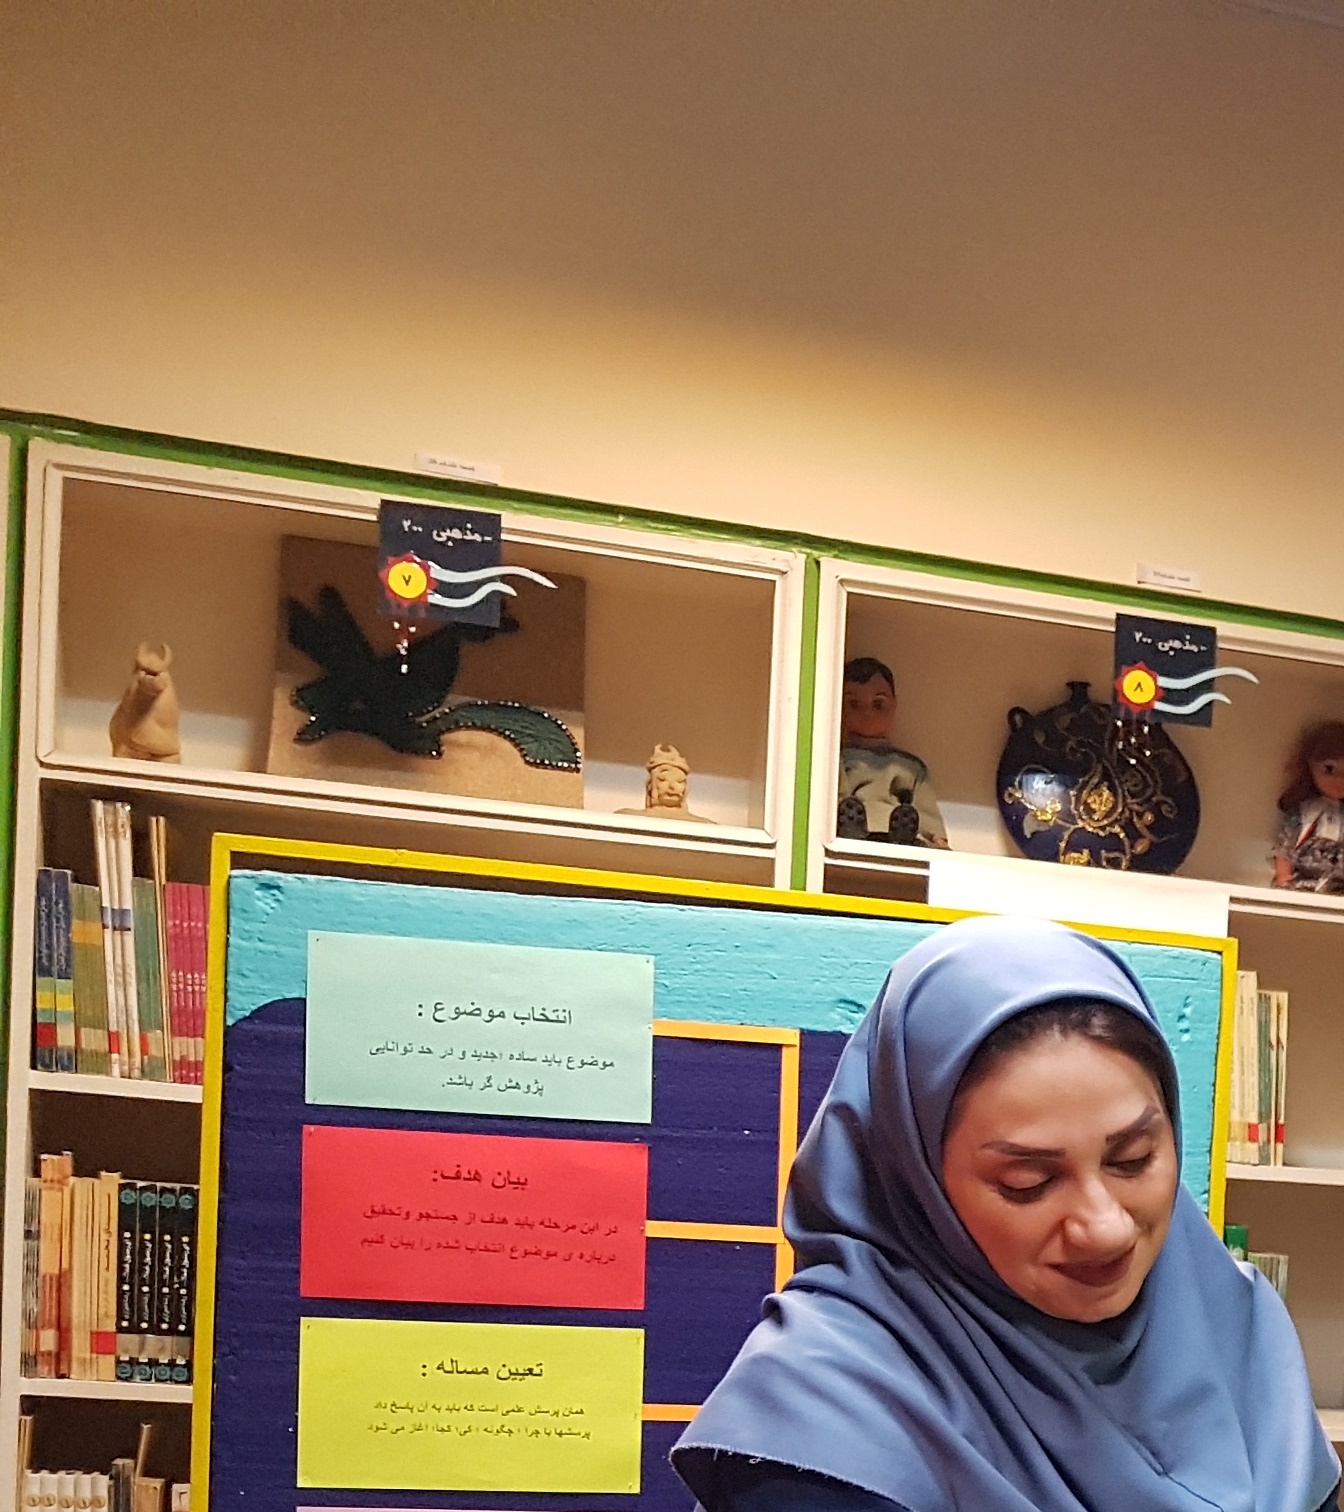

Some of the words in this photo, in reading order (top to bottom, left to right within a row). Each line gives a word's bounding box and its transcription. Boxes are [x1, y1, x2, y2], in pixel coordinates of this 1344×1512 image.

[402, 574, 412, 586] ۷
[1134, 681, 1144, 693] ۸
[432, 1001, 506, 1023] موضوع
[513, 1006, 572, 1025] انتخاب
[369, 1041, 414, 1055] توانایی
[418, 1045, 434, 1055] حد
[439, 1047, 453, 1059] در
[459, 1050, 466, 1060] و
[508, 1051, 537, 1061] ساده
[541, 1053, 562, 1066] باید
[566, 1055, 614, 1070] موضوع
[479, 1075, 493, 1091] گر
[497, 1078, 544, 1096] پژوهش
[491, 1170, 528, 1191] بیان
[415, 1209, 458, 1224] جستجو
[464, 1211, 476, 1225] از
[481, 1213, 508, 1224] هدف
[514, 1216, 535, 1230] باید
[539, 1217, 577, 1233] مرحله
[580, 1222, 599, 1235] این
[604, 1225, 618, 1236] در
[390, 1234, 415, 1249] بیان
[436, 1240, 460, 1249] شده
[465, 1241, 505, 1254] انتخاب
[509, 1245, 558, 1260] موضوع
[436, 1357, 489, 1375] مساله
[496, 1362, 543, 1381] تعیین
[390, 1400, 414, 1414] پاسخ
[431, 1403, 441, 1413] به
[445, 1403, 460, 1413] باید
[463, 1403, 475, 1411] که
[478, 1404, 498, 1412] است
[501, 1404, 525, 1416] علمی
[528, 1404, 560, 1418] پرسش
[562, 1406, 585, 1417] همان
[390, 1426, 405, 1434] می
[483, 1424, 514, 1437] چگونه
[525, 1427, 540, 1438] چرا
[544, 1427, 552, 1437] با
[554, 1427, 590, 1440] پرسشها
